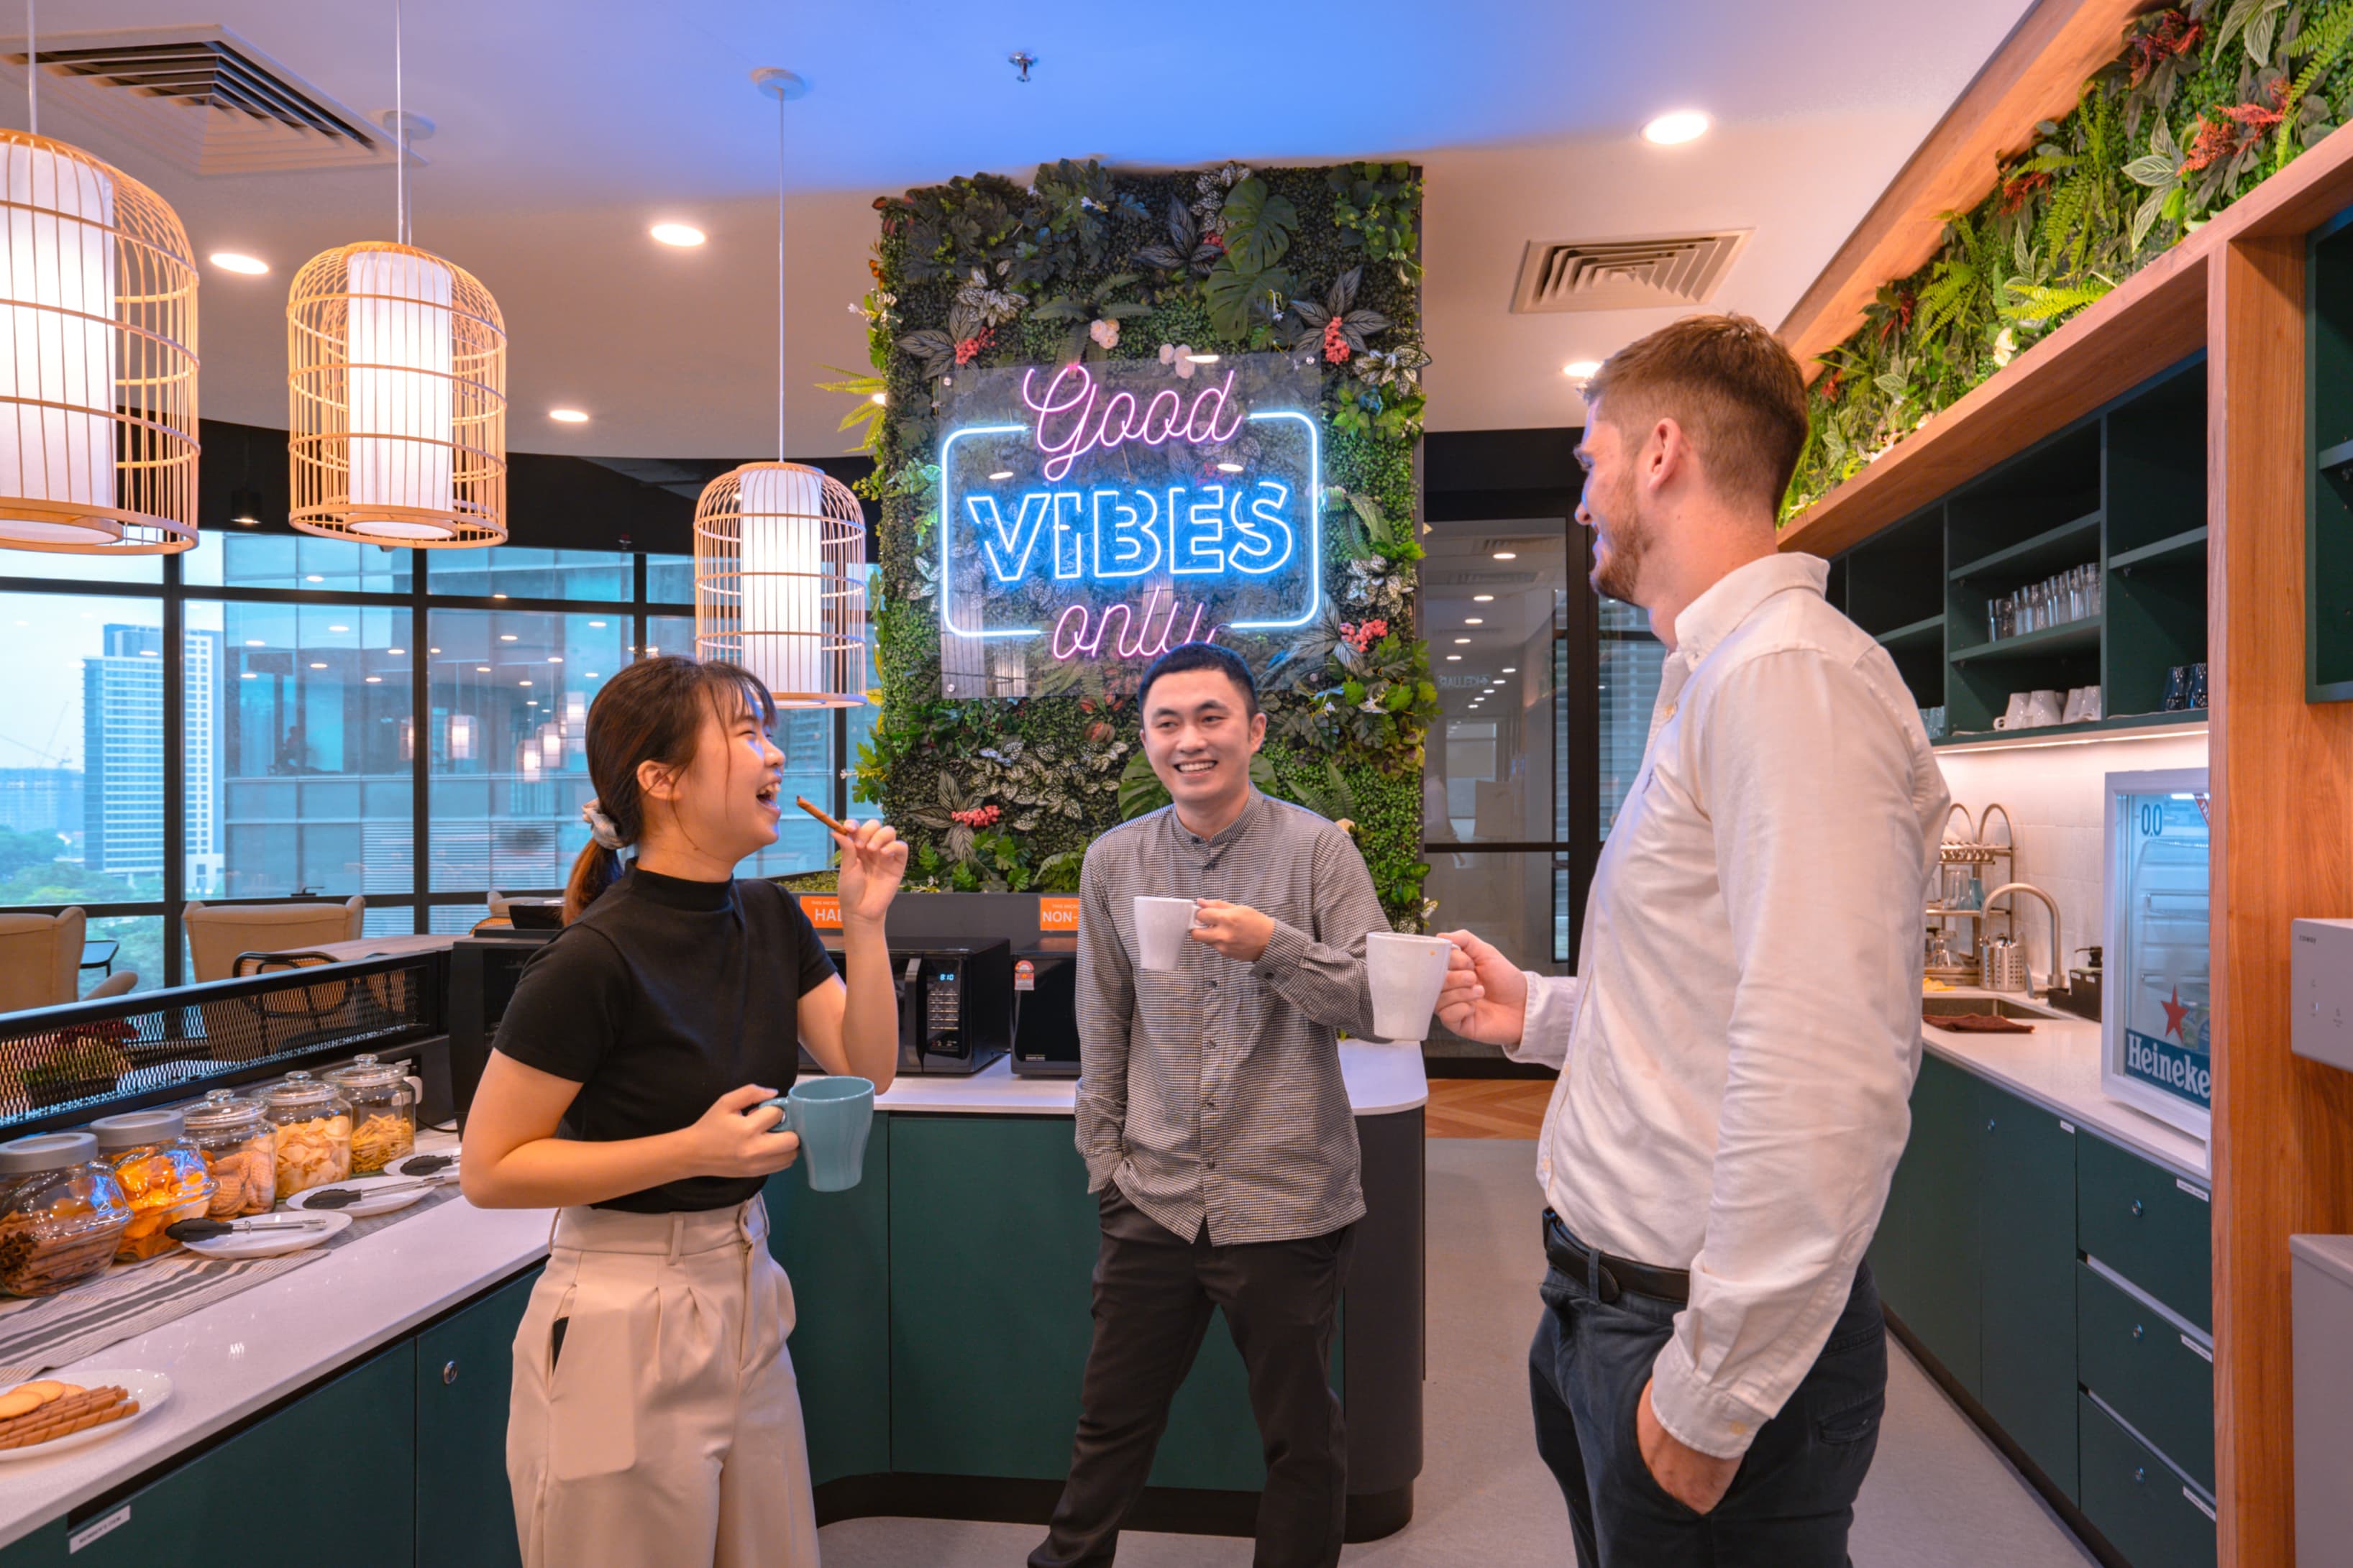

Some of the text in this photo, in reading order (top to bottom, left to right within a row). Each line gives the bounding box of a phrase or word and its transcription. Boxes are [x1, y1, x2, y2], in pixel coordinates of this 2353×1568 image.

[1022, 365, 1243, 482] Good
[966, 482, 1293, 582] VIBES
[2141, 804, 2162, 837] 0.0
[815, 908, 841, 922] HAL
[2127, 1033, 2211, 1099] Heineke
